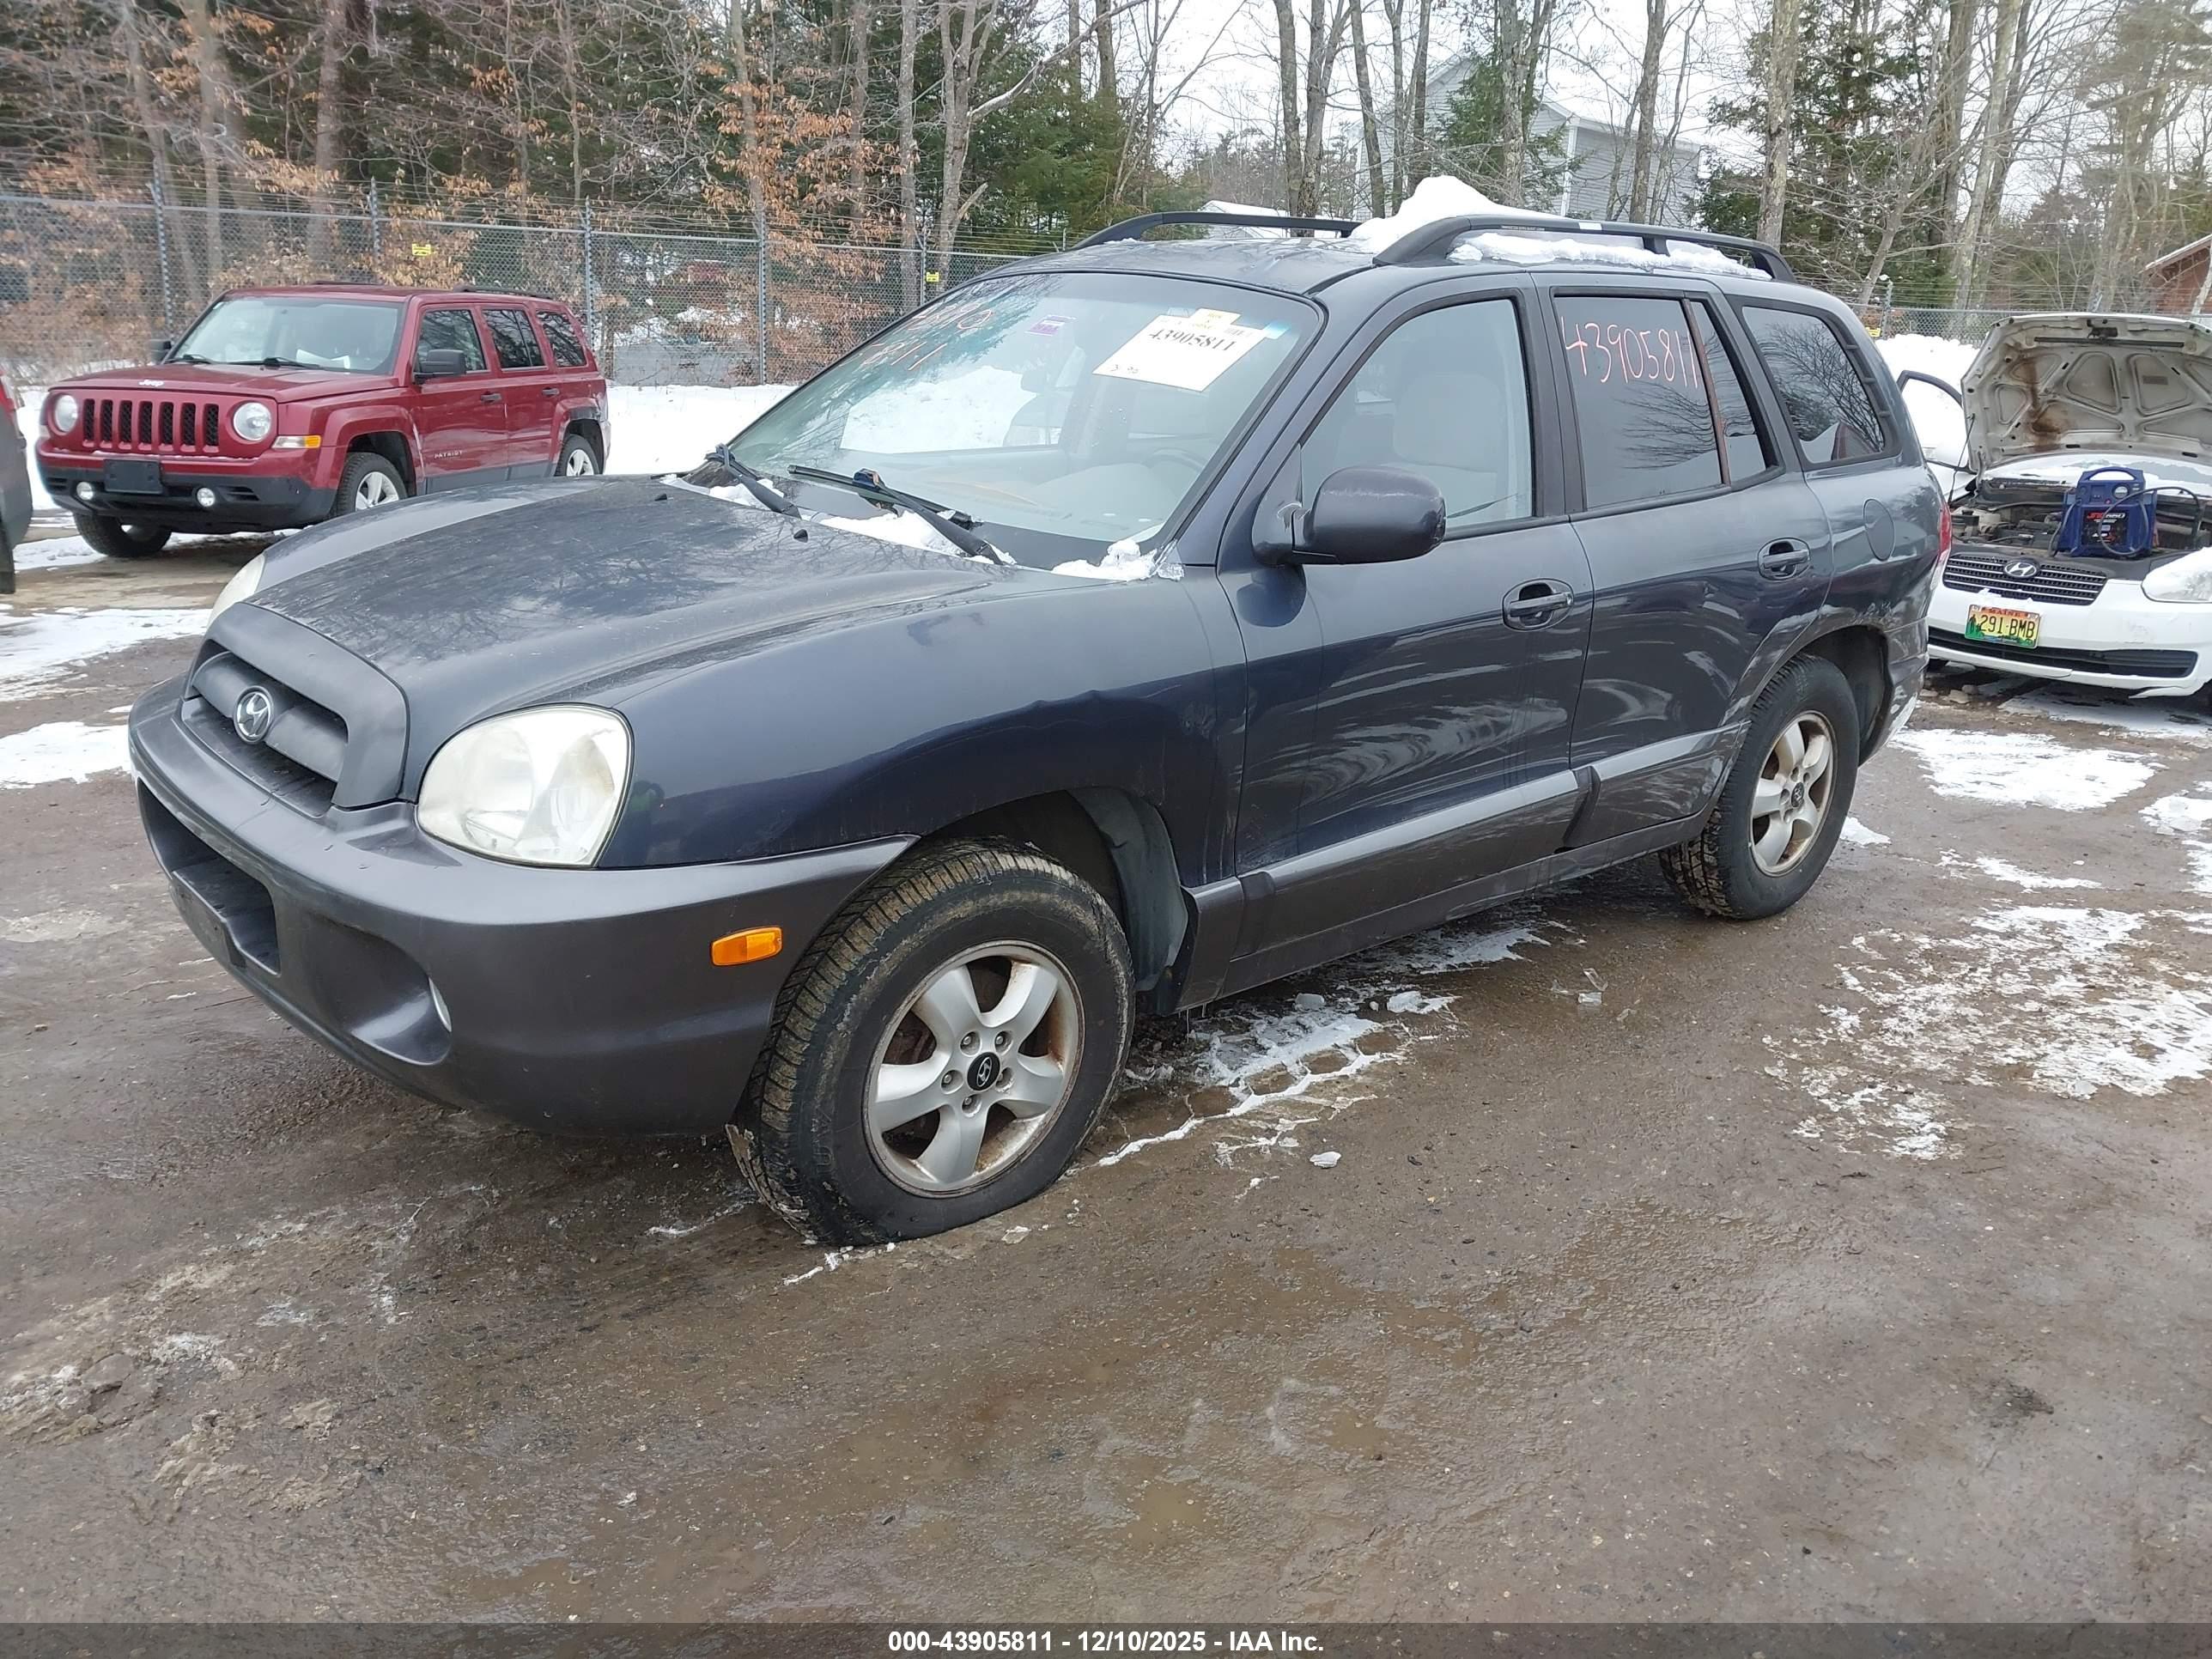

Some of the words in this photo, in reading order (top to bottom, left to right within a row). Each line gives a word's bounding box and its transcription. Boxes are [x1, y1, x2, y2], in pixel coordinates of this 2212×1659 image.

[1149, 328, 1237, 351] 43905811
[1561, 316, 1698, 389] 43905811
[1989, 609, 2021, 617] MAINE
